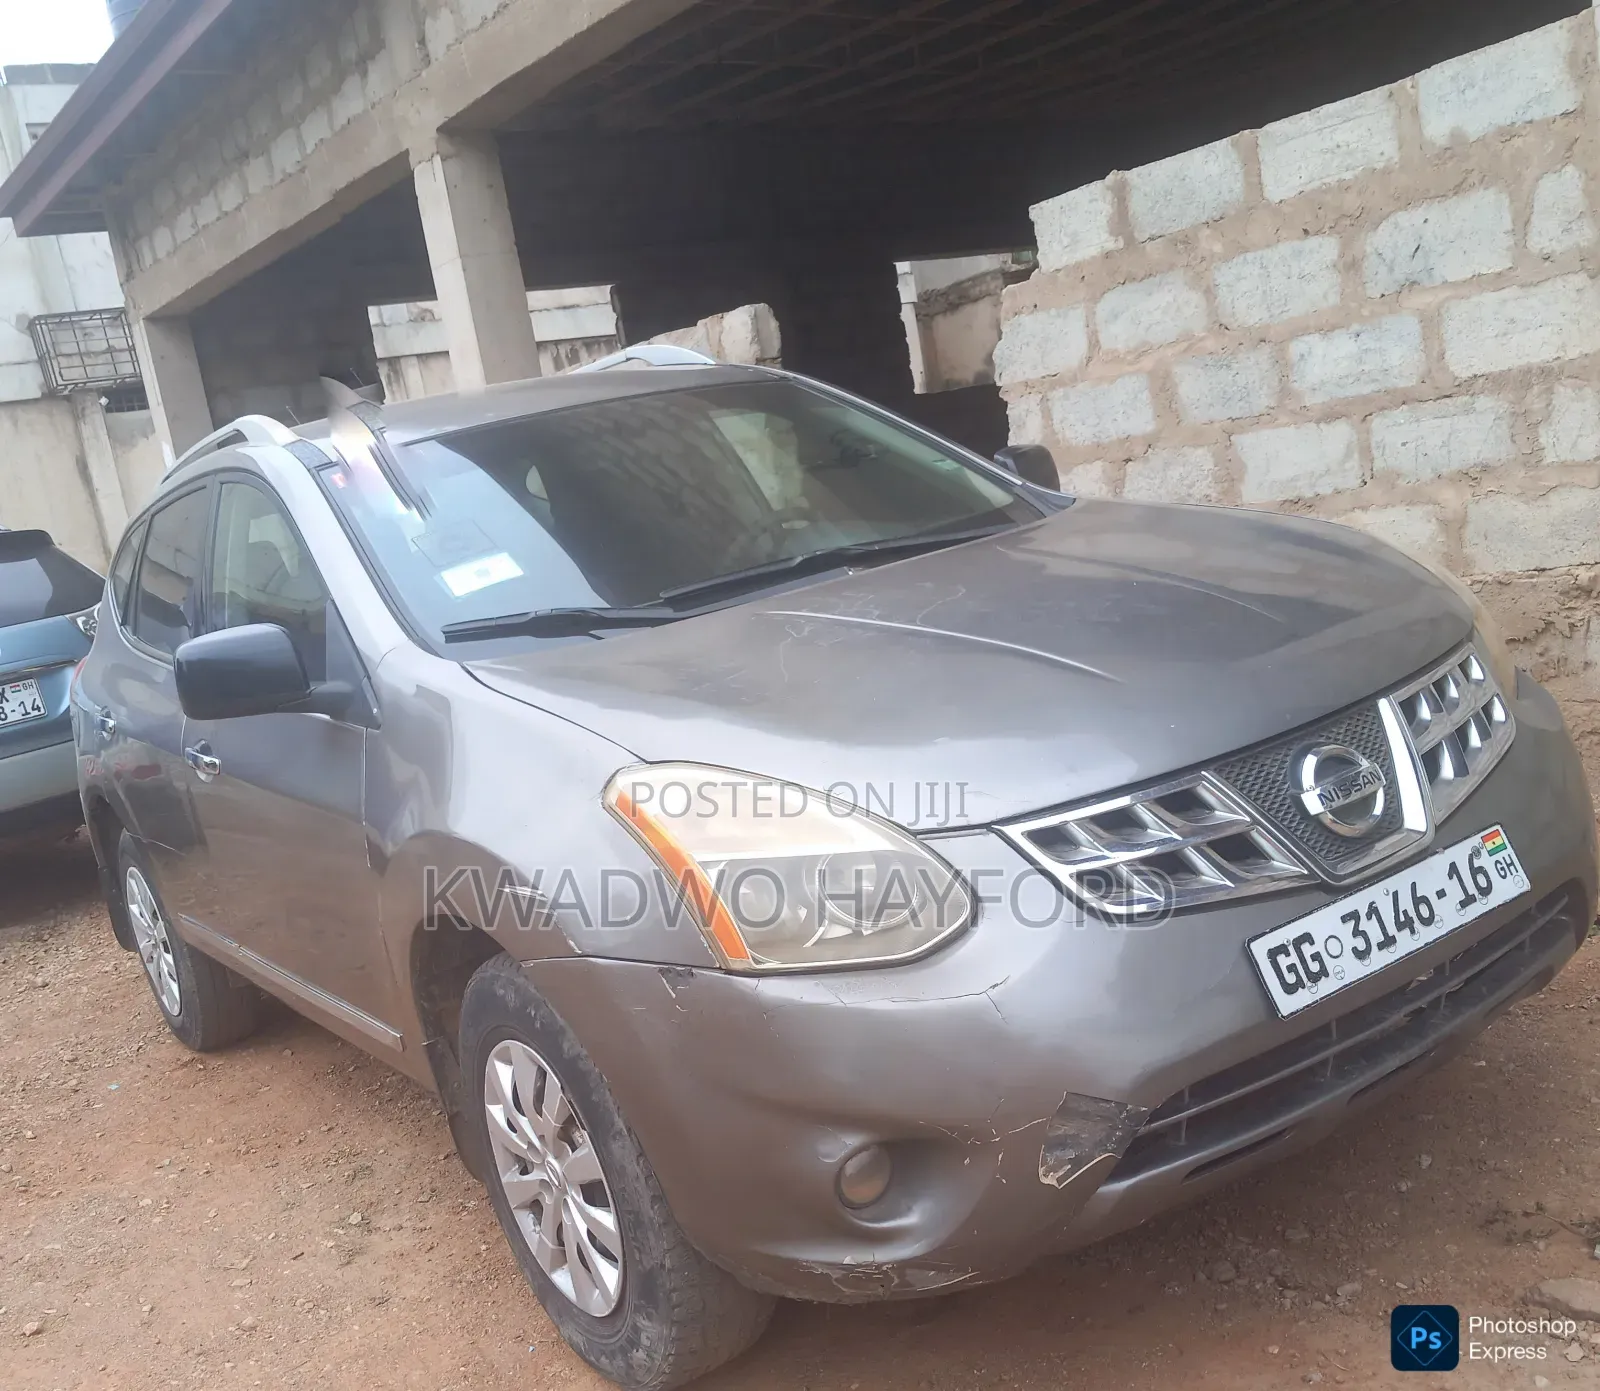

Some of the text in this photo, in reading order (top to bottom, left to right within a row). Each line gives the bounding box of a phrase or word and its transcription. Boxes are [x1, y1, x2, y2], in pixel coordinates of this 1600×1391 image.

[22, 681, 34, 691] GH
[1317, 769, 1382, 807] NISSAN
[1494, 857, 1519, 879] GH
[1267, 853, 1493, 995] GG 3146-16
